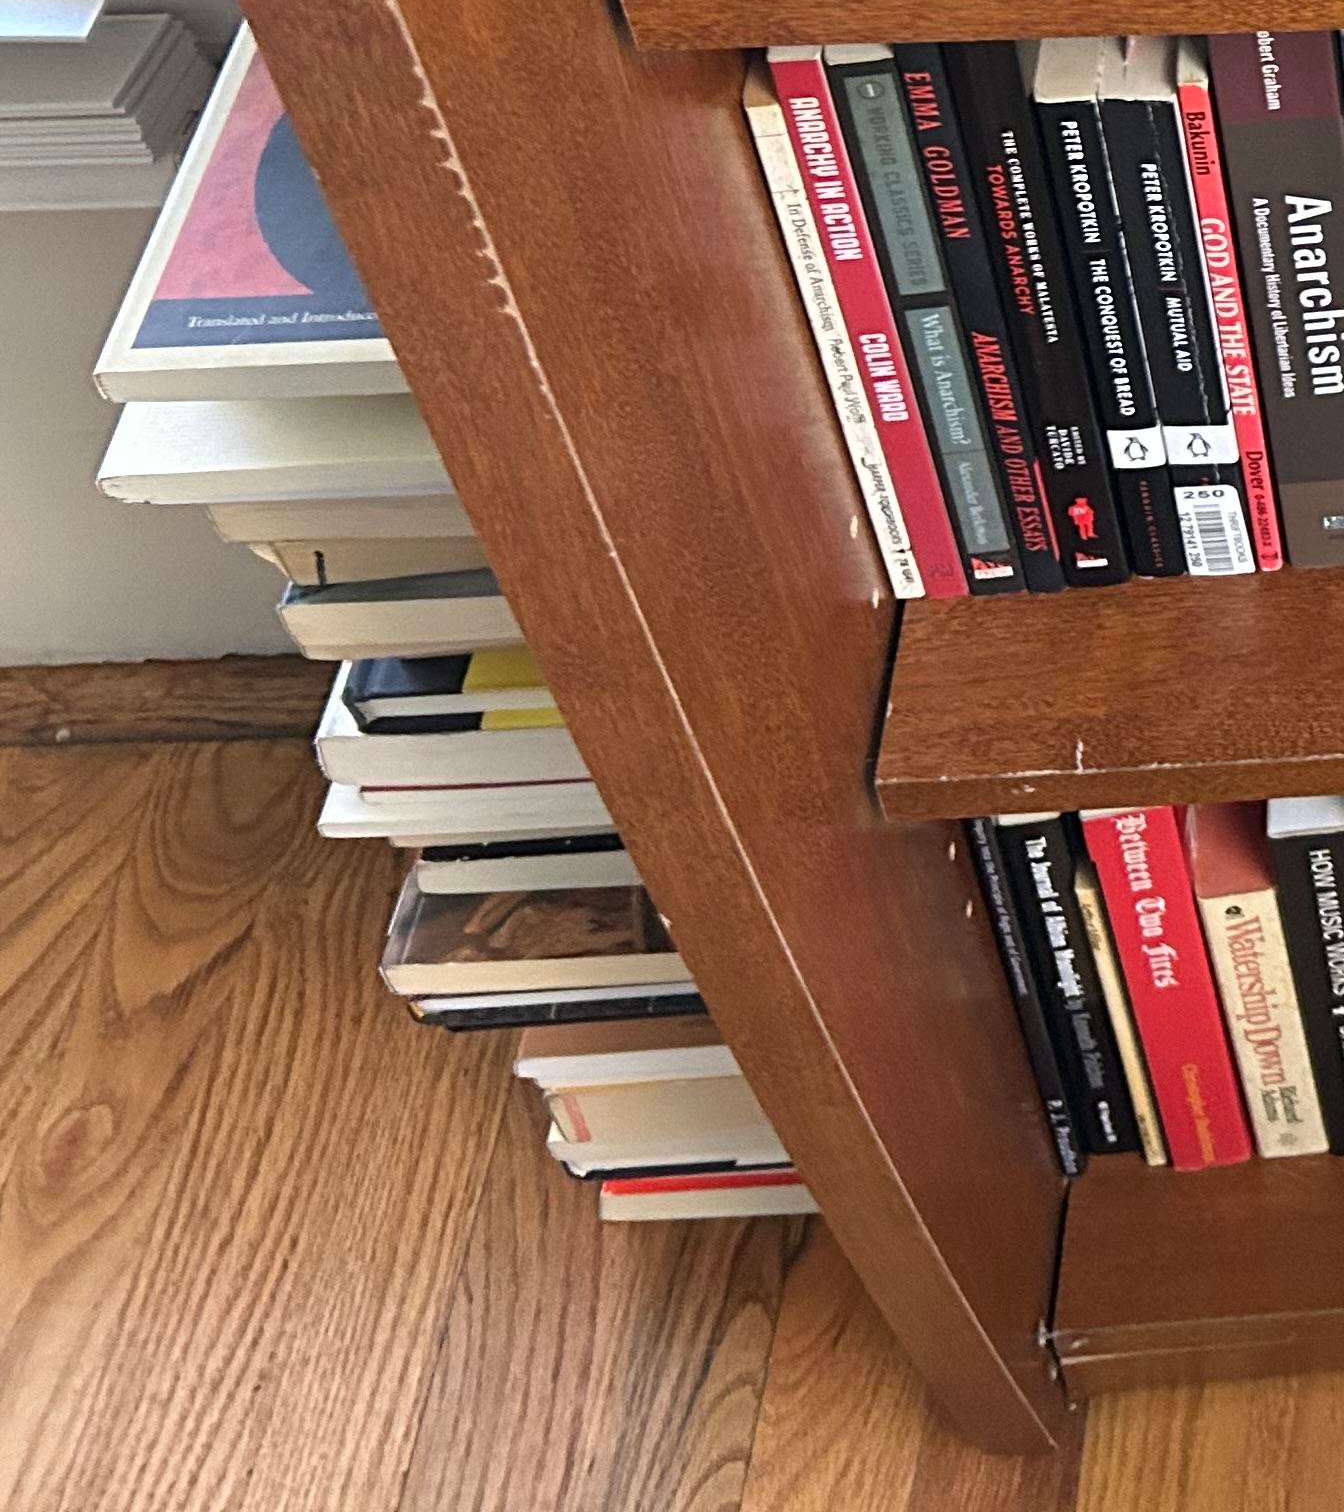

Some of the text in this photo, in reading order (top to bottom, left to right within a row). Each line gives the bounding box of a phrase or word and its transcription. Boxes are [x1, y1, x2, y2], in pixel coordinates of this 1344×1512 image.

[789, 96, 863, 261] ANARCHY IN ACTION
[904, 72, 971, 238] EMMA GOLDMAN
[1060, 121, 1101, 243] PETER KROPOTKIN
[1186, 111, 1216, 175] Bakunin
[1089, 259, 1135, 416] THE CONQUEST OF BREAD
[1200, 218, 1256, 415] GOD AND THE STATE
[859, 333, 909, 422] COLIN WARD
[1309, 849, 1336, 888] HOW
[1316, 891, 1344, 941] MUSIC
[1225, 916, 1277, 1024] Watership
[1244, 1025, 1286, 1087] Down
